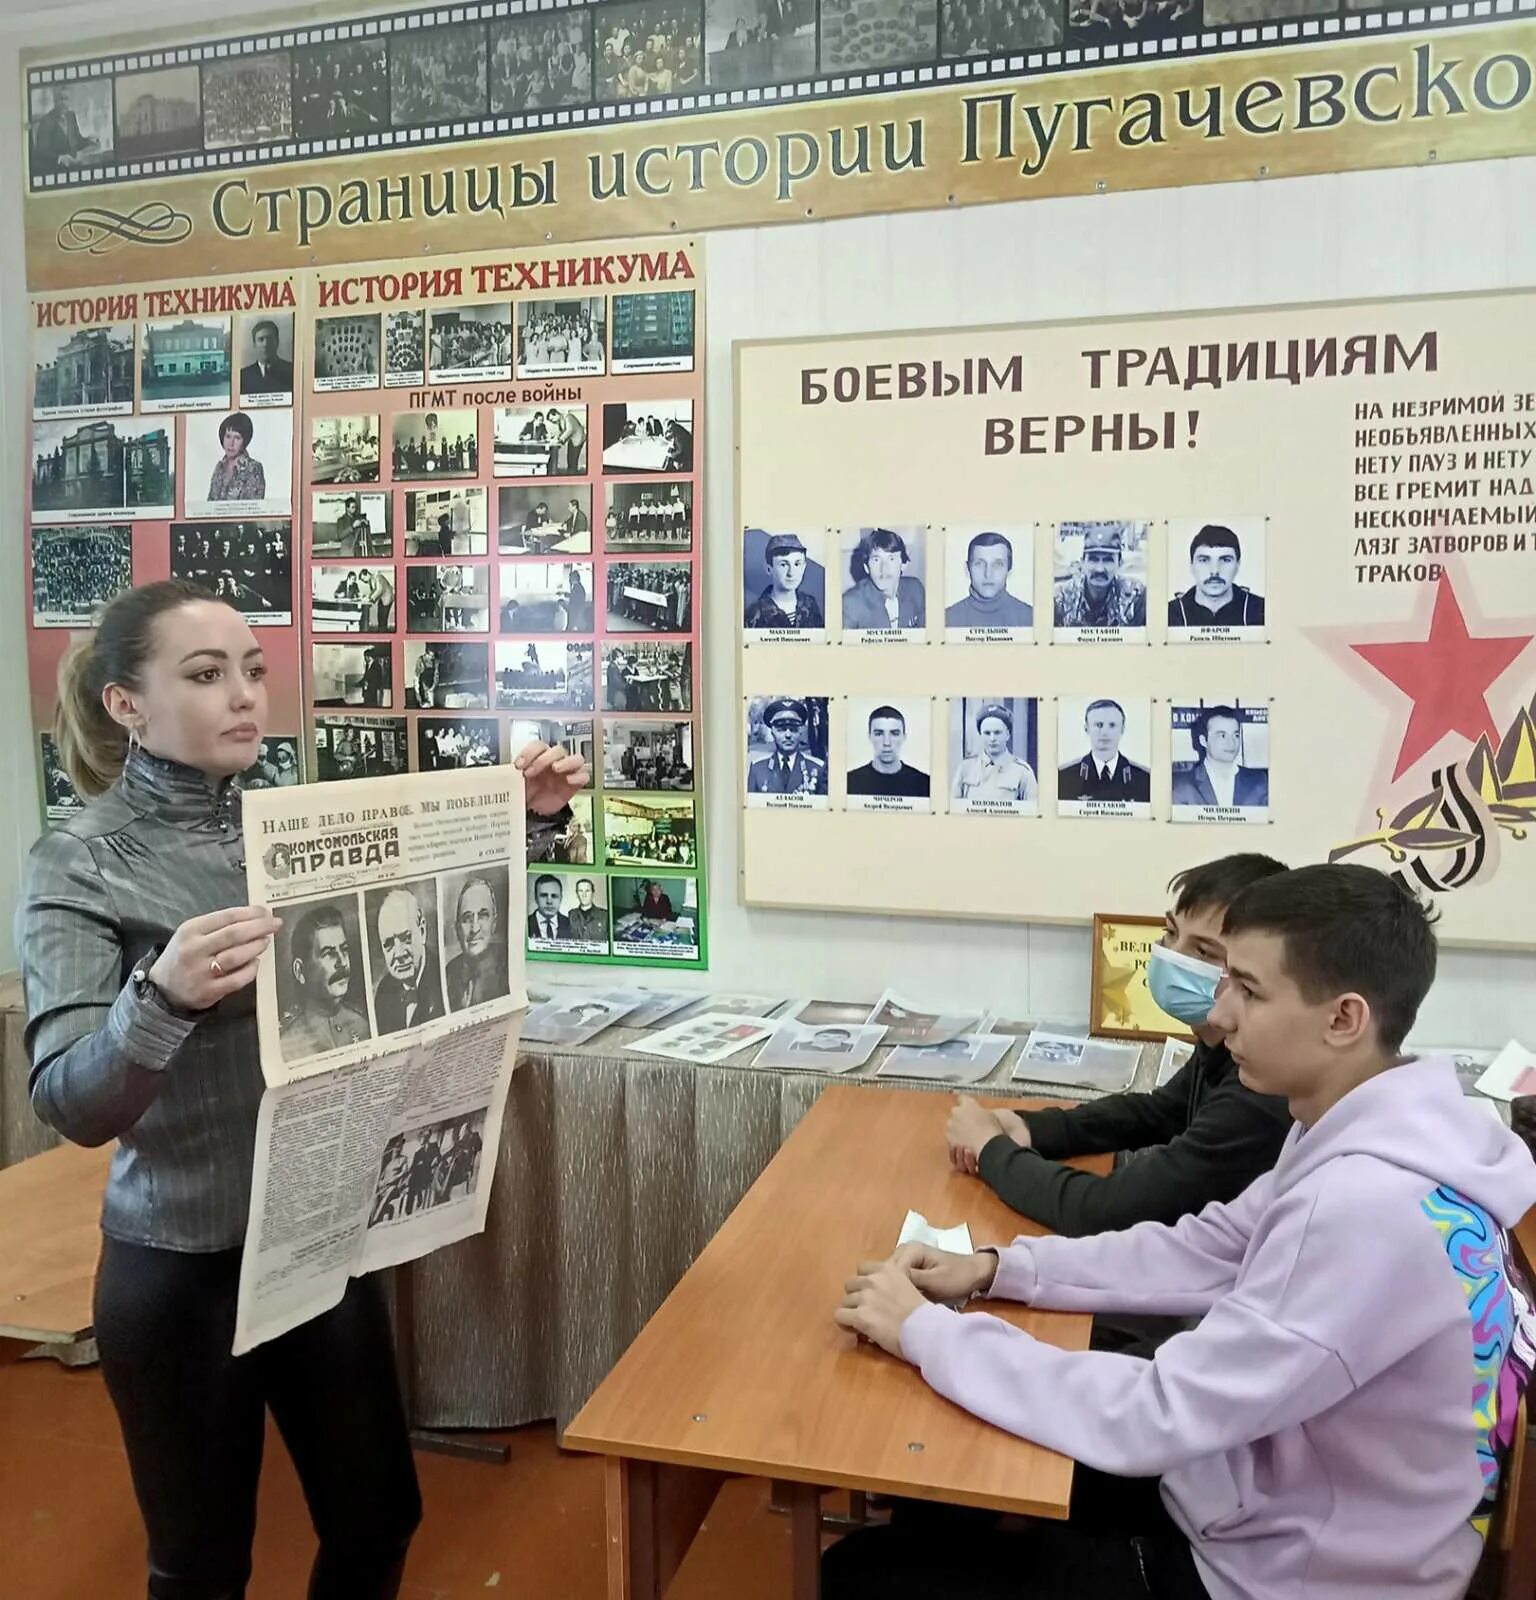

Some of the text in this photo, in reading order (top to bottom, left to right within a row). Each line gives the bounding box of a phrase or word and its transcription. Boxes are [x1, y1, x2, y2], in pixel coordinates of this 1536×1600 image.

[213, 43, 1534, 247] Страницы истории Пугачевско
[317, 251, 695, 308] ИСТОРИЯ ТЕХНИКУМА
[36, 281, 296, 328] ИСТОРИЯ ТЕХНИКУМА
[801, 331, 1438, 405] БОЕВЫМ ТРАДИЦИЯМ
[409, 383, 582, 409] ПГМТ после войны
[1354, 402, 1384, 421] НА
[1391, 390, 1505, 418] НЕЗРИМОЙ
[982, 410, 1202, 457] ВЕРНЫ!
[1354, 421, 1536, 448] НЕОБЪЯВЛЕННЫХ
[1354, 448, 1532, 475] НЕТУ ПАУЗ И НЕТУ
[1354, 477, 1535, 502] ВСЕ ГРЕМИТ НАД
[1354, 501, 1536, 529] НЕСКОНЧАЕМЫЙ
[1353, 535, 1401, 557] ЛЯЗГ
[1407, 533, 1508, 555] ЗАТВОРОВ
[1513, 532, 1526, 552] И
[1354, 563, 1442, 584] ТРАКОВ
[262, 816, 309, 835] НАШЕ
[318, 810, 355, 828] ДЕЛО
[421, 800, 441, 814] МЫ
[289, 826, 399, 856] КОМСОМОЛЬСКАЯ
[290, 840, 401, 876] ПРАВДА
